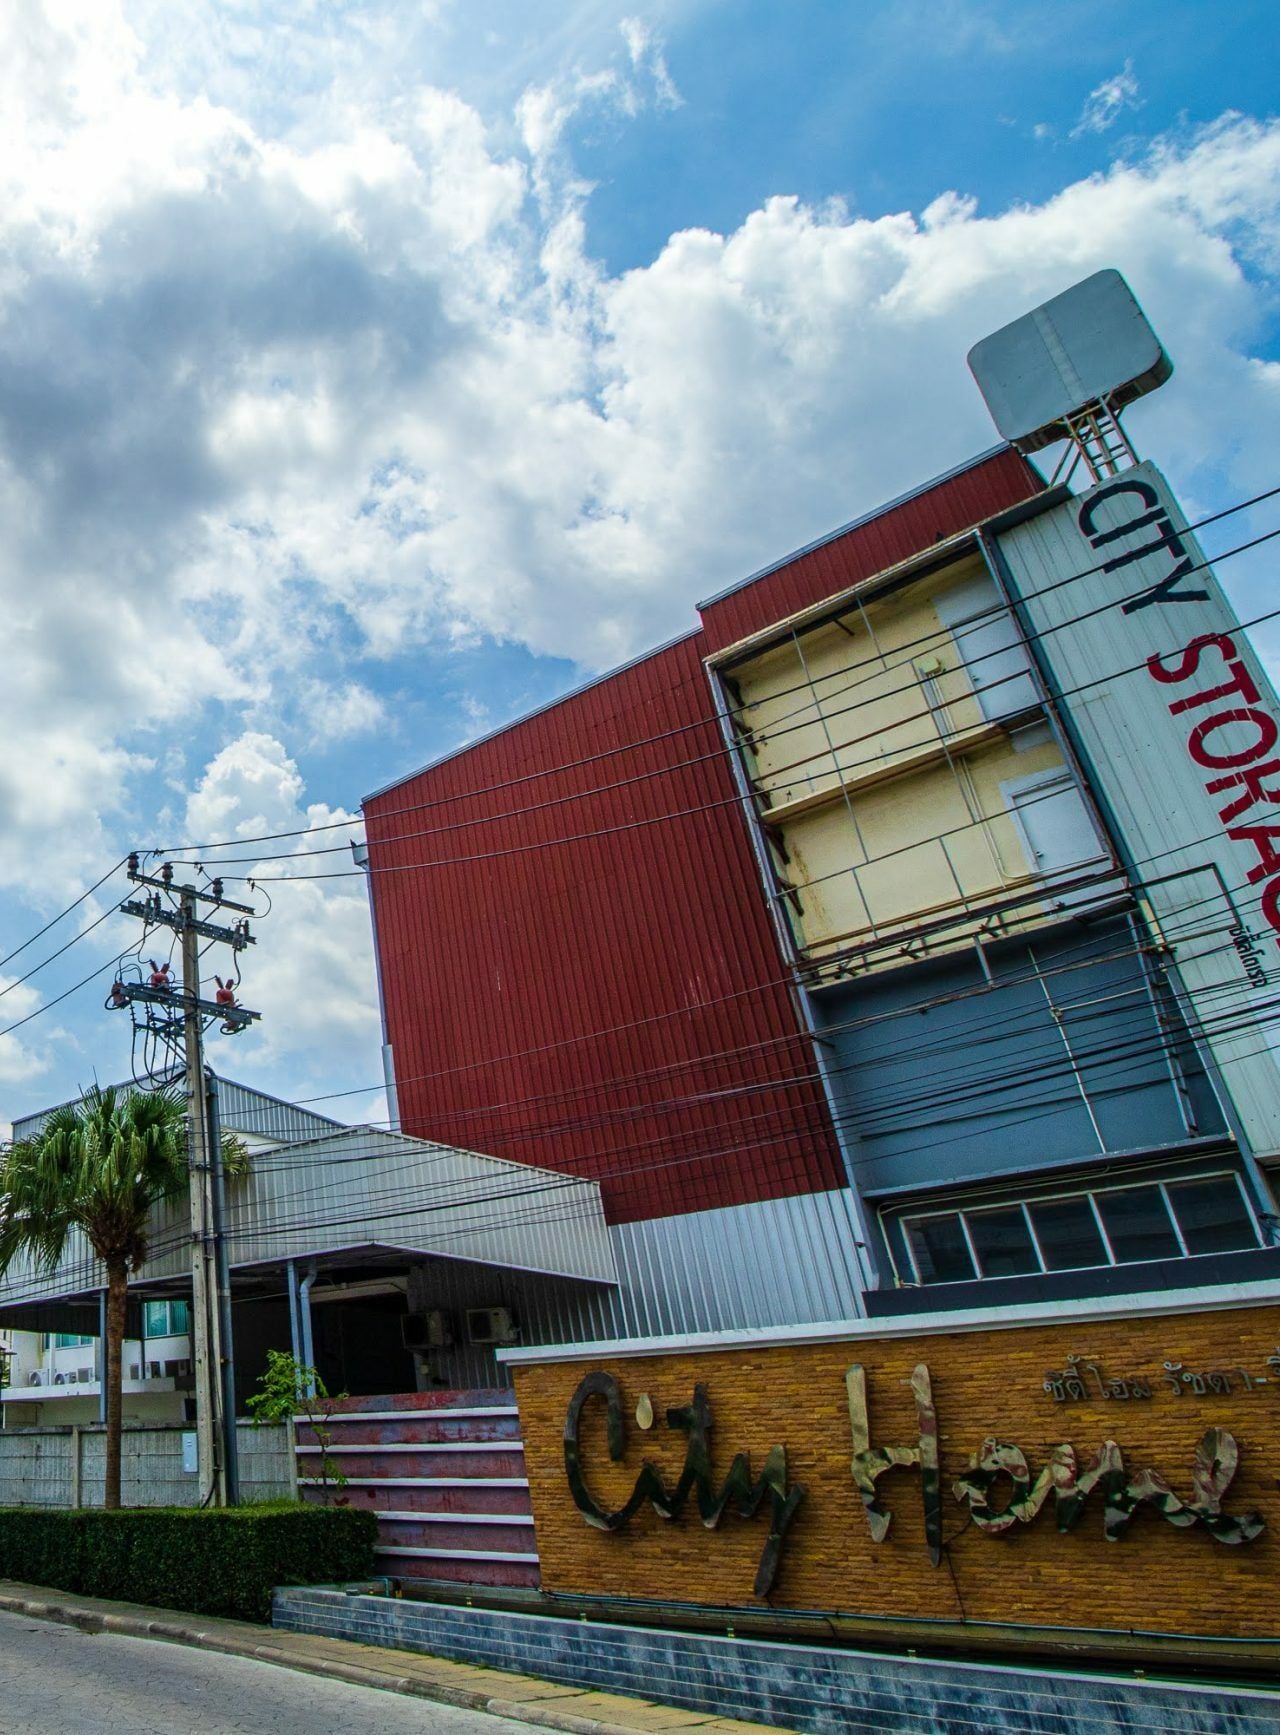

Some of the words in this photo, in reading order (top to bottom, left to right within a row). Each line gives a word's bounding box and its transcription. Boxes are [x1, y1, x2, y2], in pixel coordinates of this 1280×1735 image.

[1078, 479, 1209, 615] CITY
[1146, 632, 1280, 940] STORA
[564, 1371, 807, 1598] City
[845, 1363, 1266, 1567] Home
